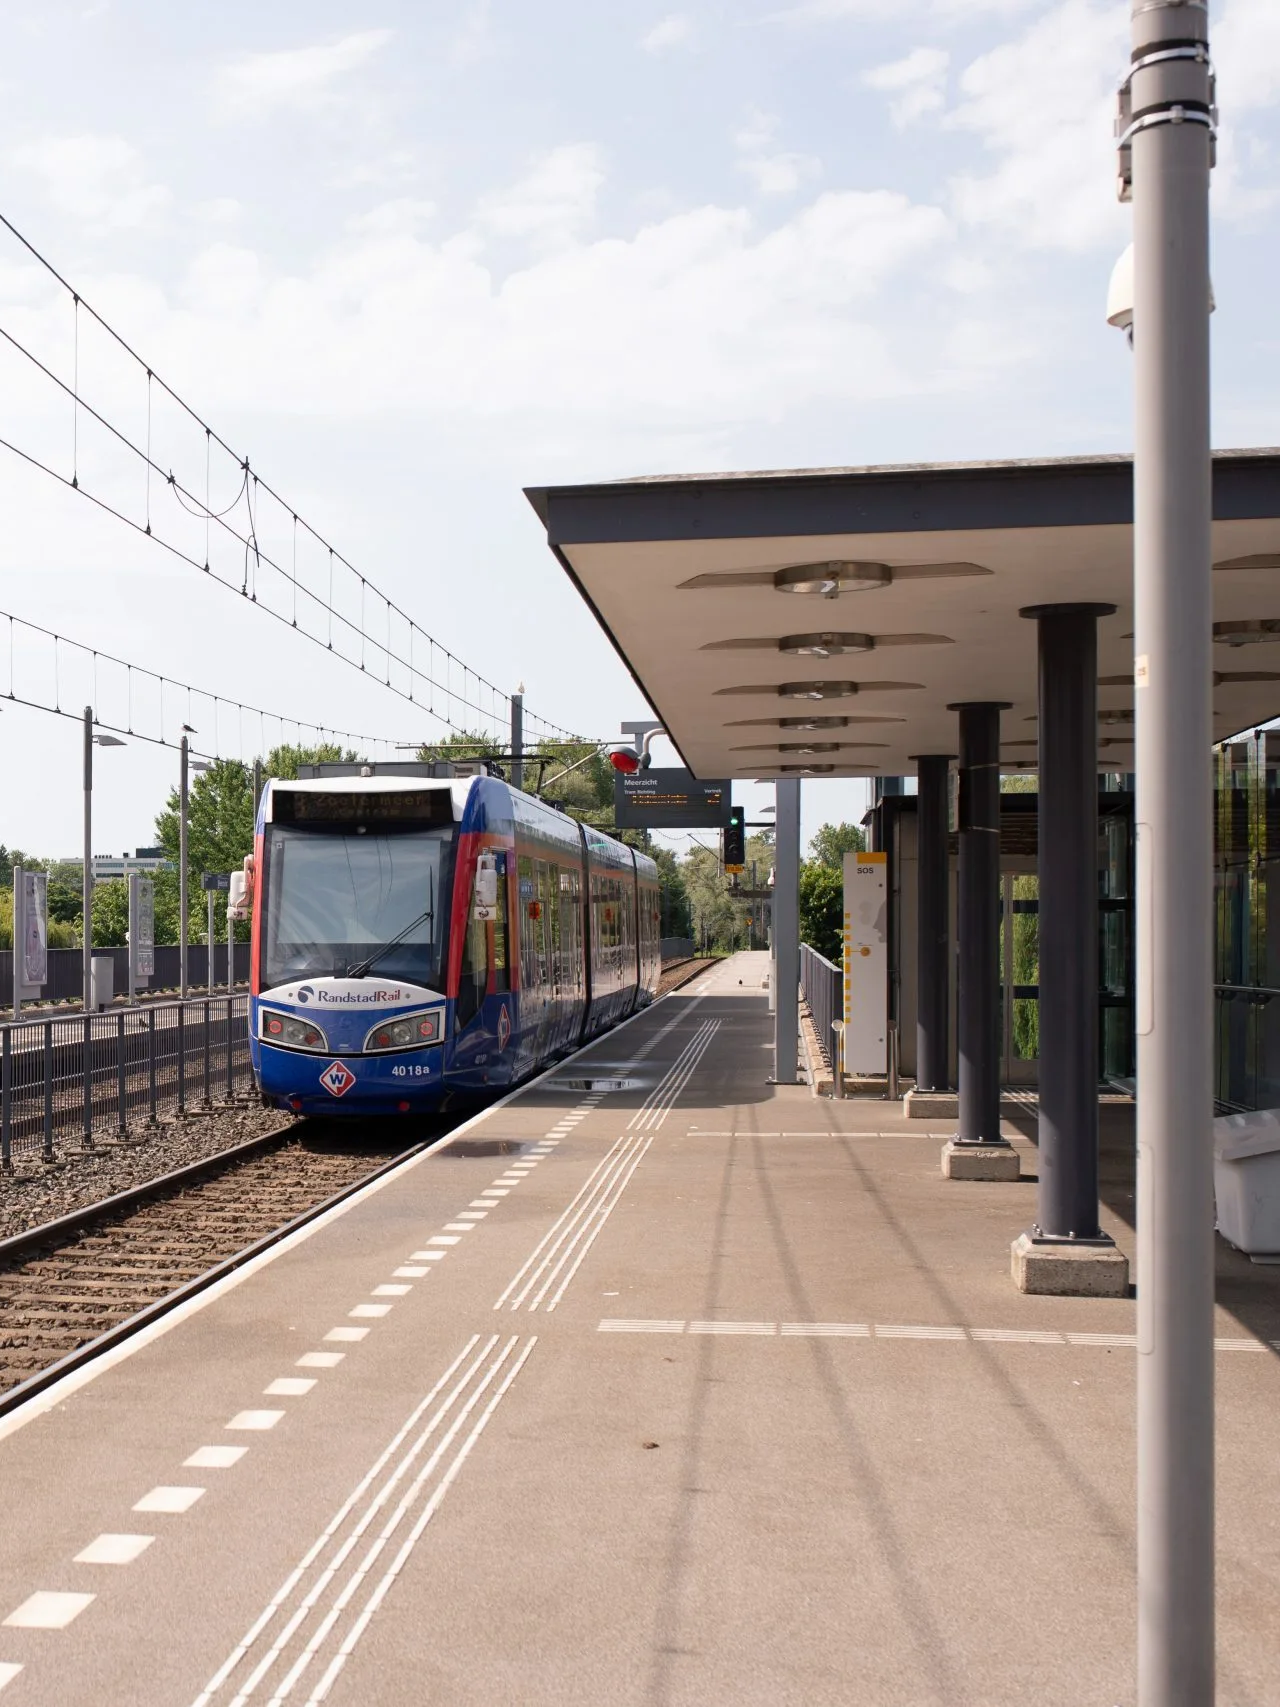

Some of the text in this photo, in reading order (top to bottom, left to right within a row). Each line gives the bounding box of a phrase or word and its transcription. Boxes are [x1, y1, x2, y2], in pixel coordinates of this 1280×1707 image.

[318, 989, 401, 1003] RandstadRail
[392, 1065, 430, 1076] 4018a
[329, 1073, 345, 1086] W
